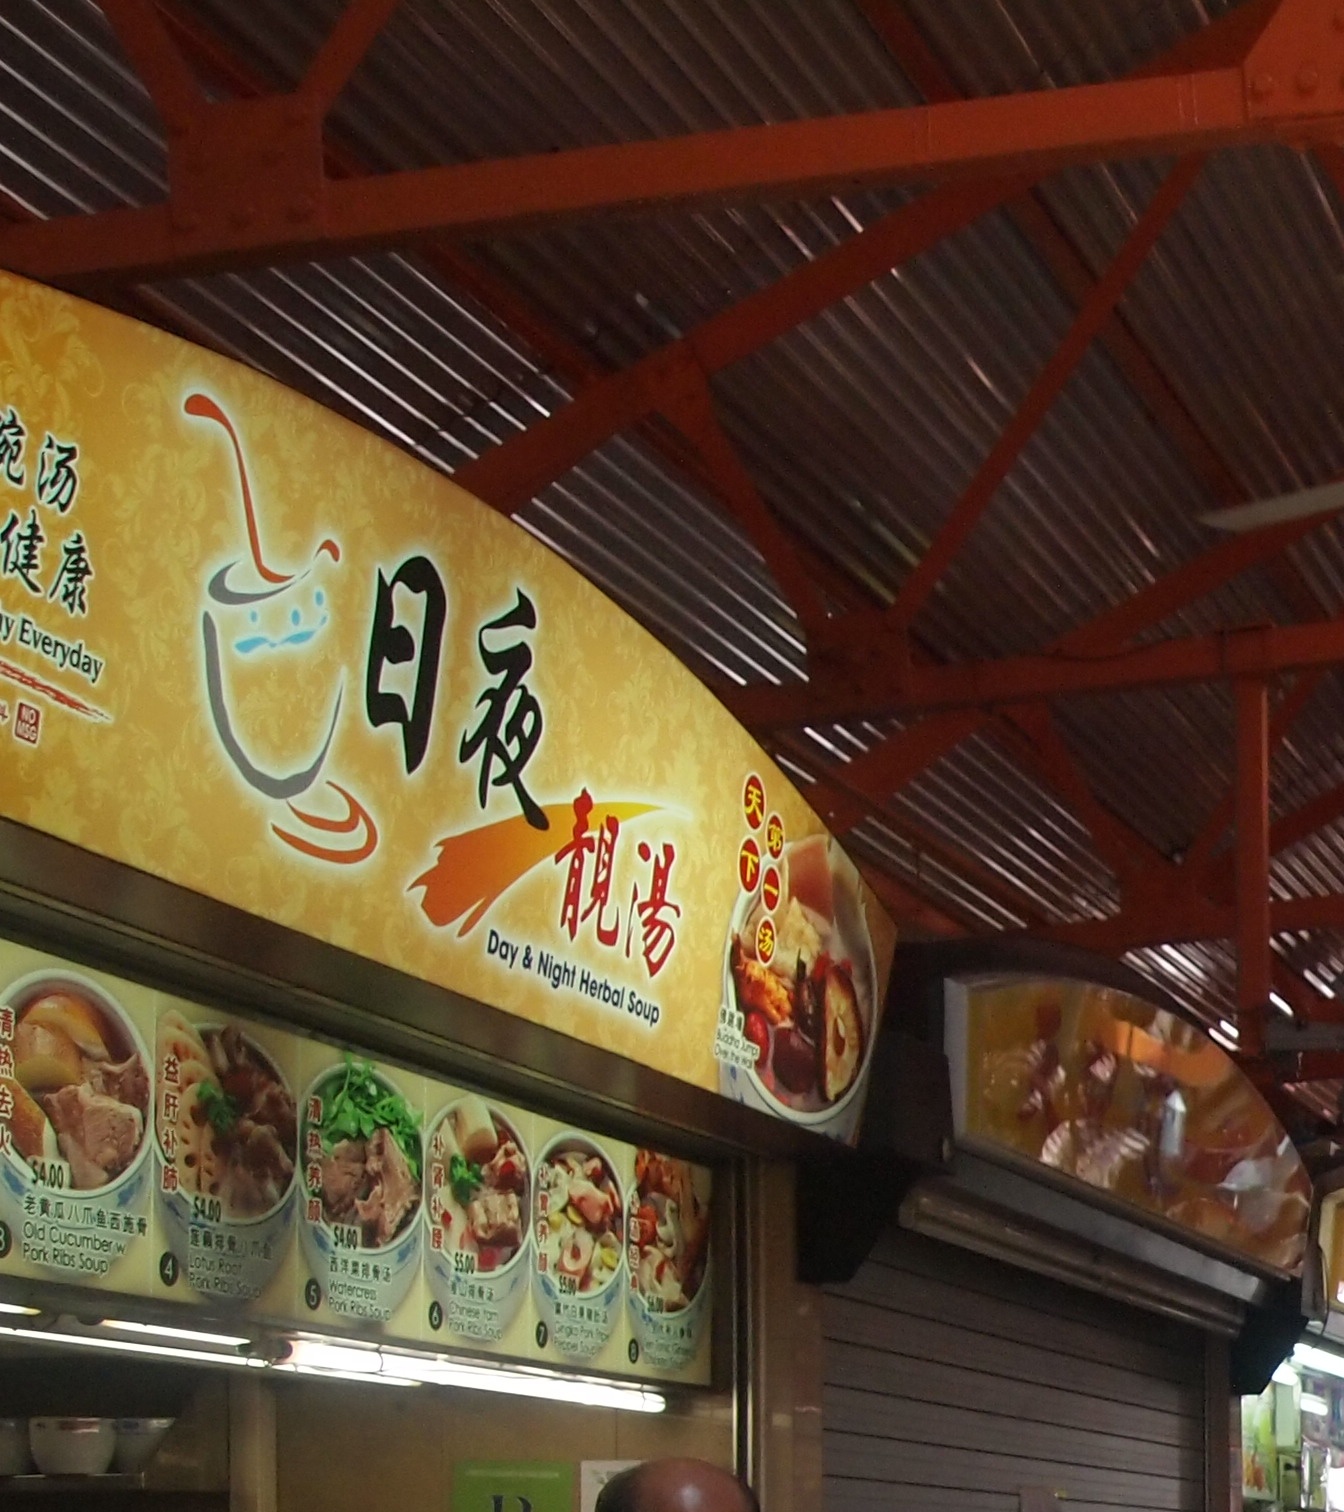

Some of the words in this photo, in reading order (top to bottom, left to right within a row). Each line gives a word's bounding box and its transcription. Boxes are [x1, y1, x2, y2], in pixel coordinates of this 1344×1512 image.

[1, 510, 93, 615] 健康
[19, 620, 103, 684] Everyday
[21, 705, 36, 725] NO
[366, 556, 549, 831] 日夜
[17, 720, 37, 741] MSG
[487, 929, 519, 969] Day
[522, 945, 533, 970] &
[537, 951, 577, 989] Night
[579, 968, 626, 1009] Herbal
[627, 991, 660, 1028] Soup
[23, 1221, 45, 1242] Old
[50, 1225, 114, 1253] Cucumber
[23, 1242, 49, 1264] Pork
[52, 1247, 76, 1269] Ribs
[78, 1254, 110, 1275] Soup
